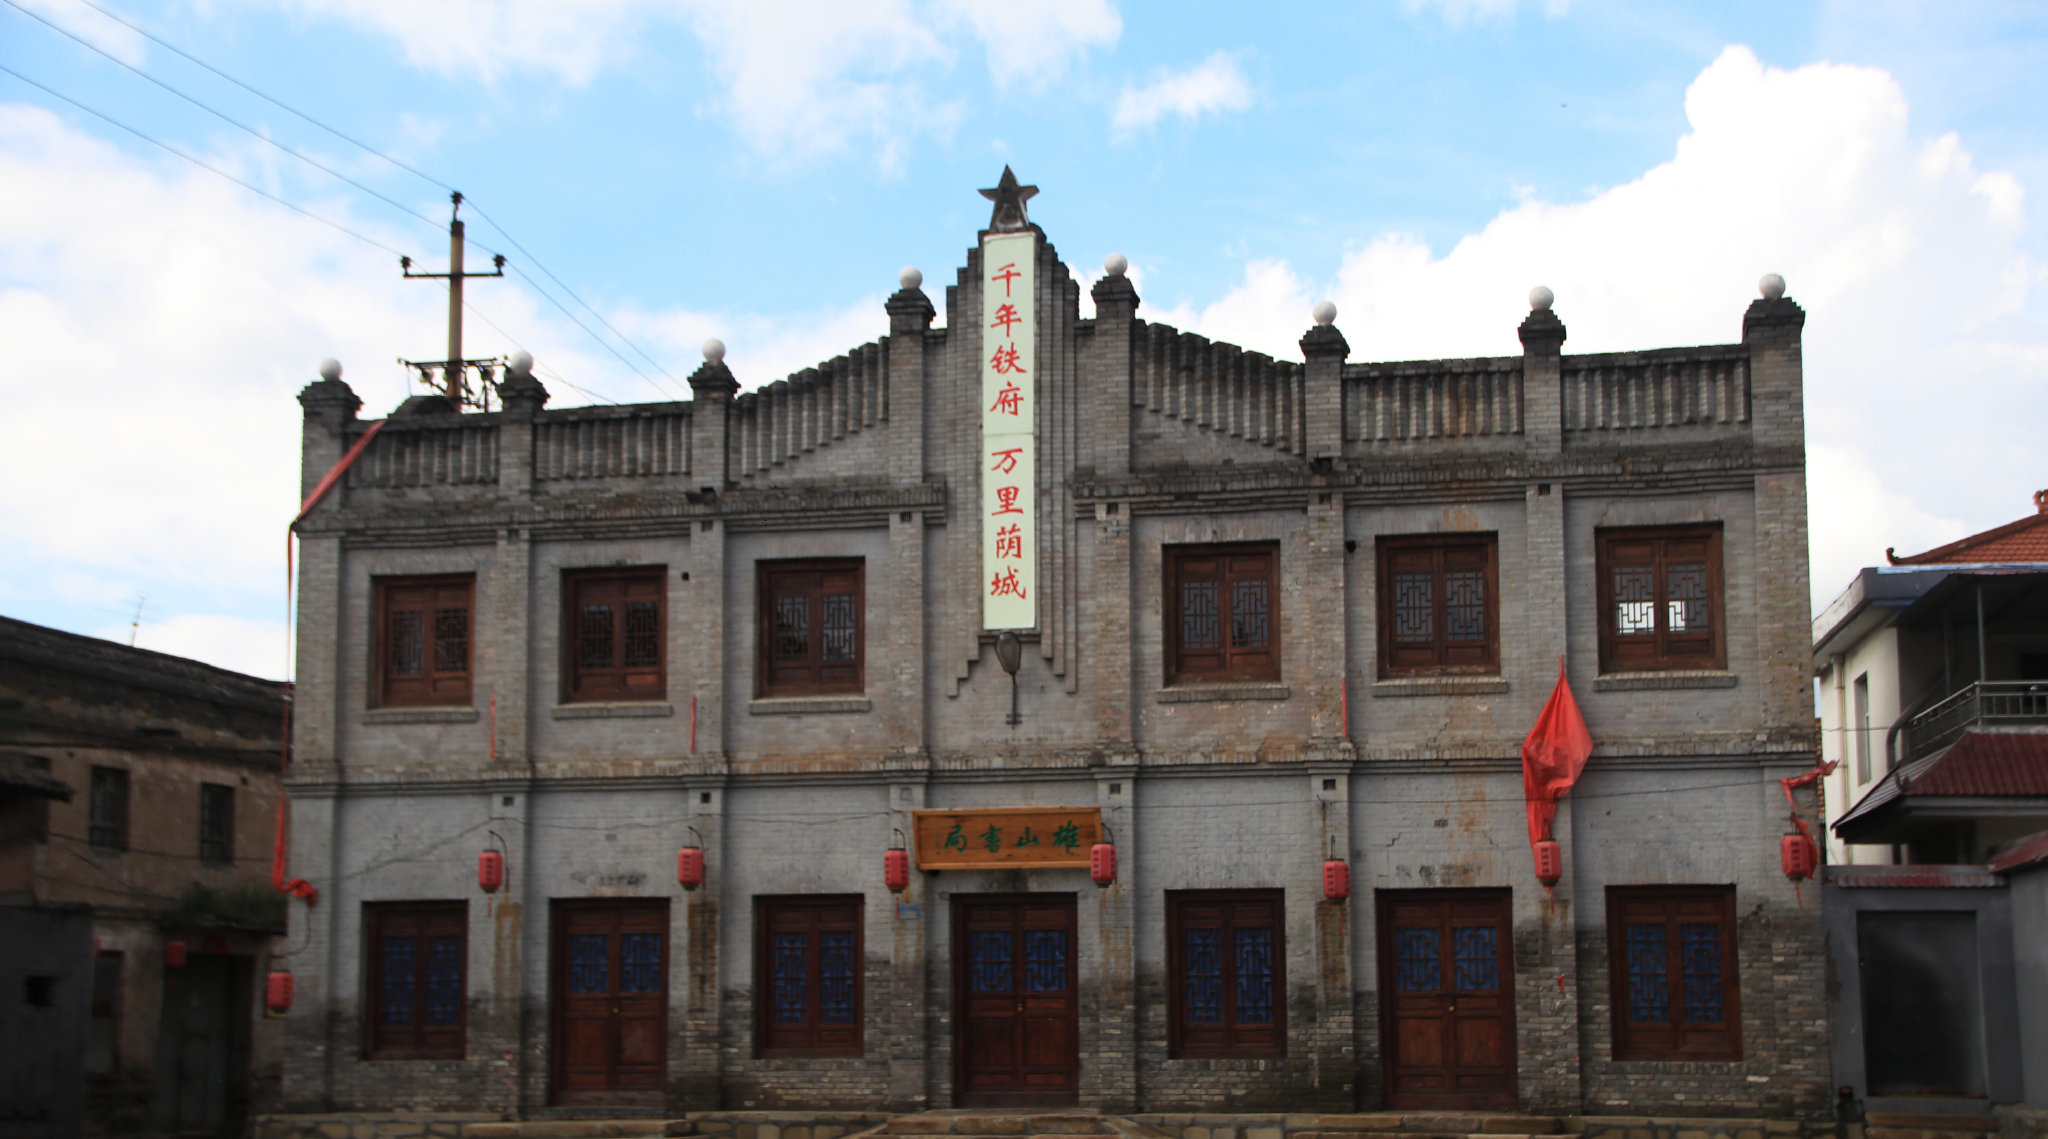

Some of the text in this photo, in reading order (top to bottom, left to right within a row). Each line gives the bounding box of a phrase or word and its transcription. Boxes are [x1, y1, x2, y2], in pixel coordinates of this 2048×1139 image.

[989, 262, 1027, 600] 千年铁府 万里荫城
